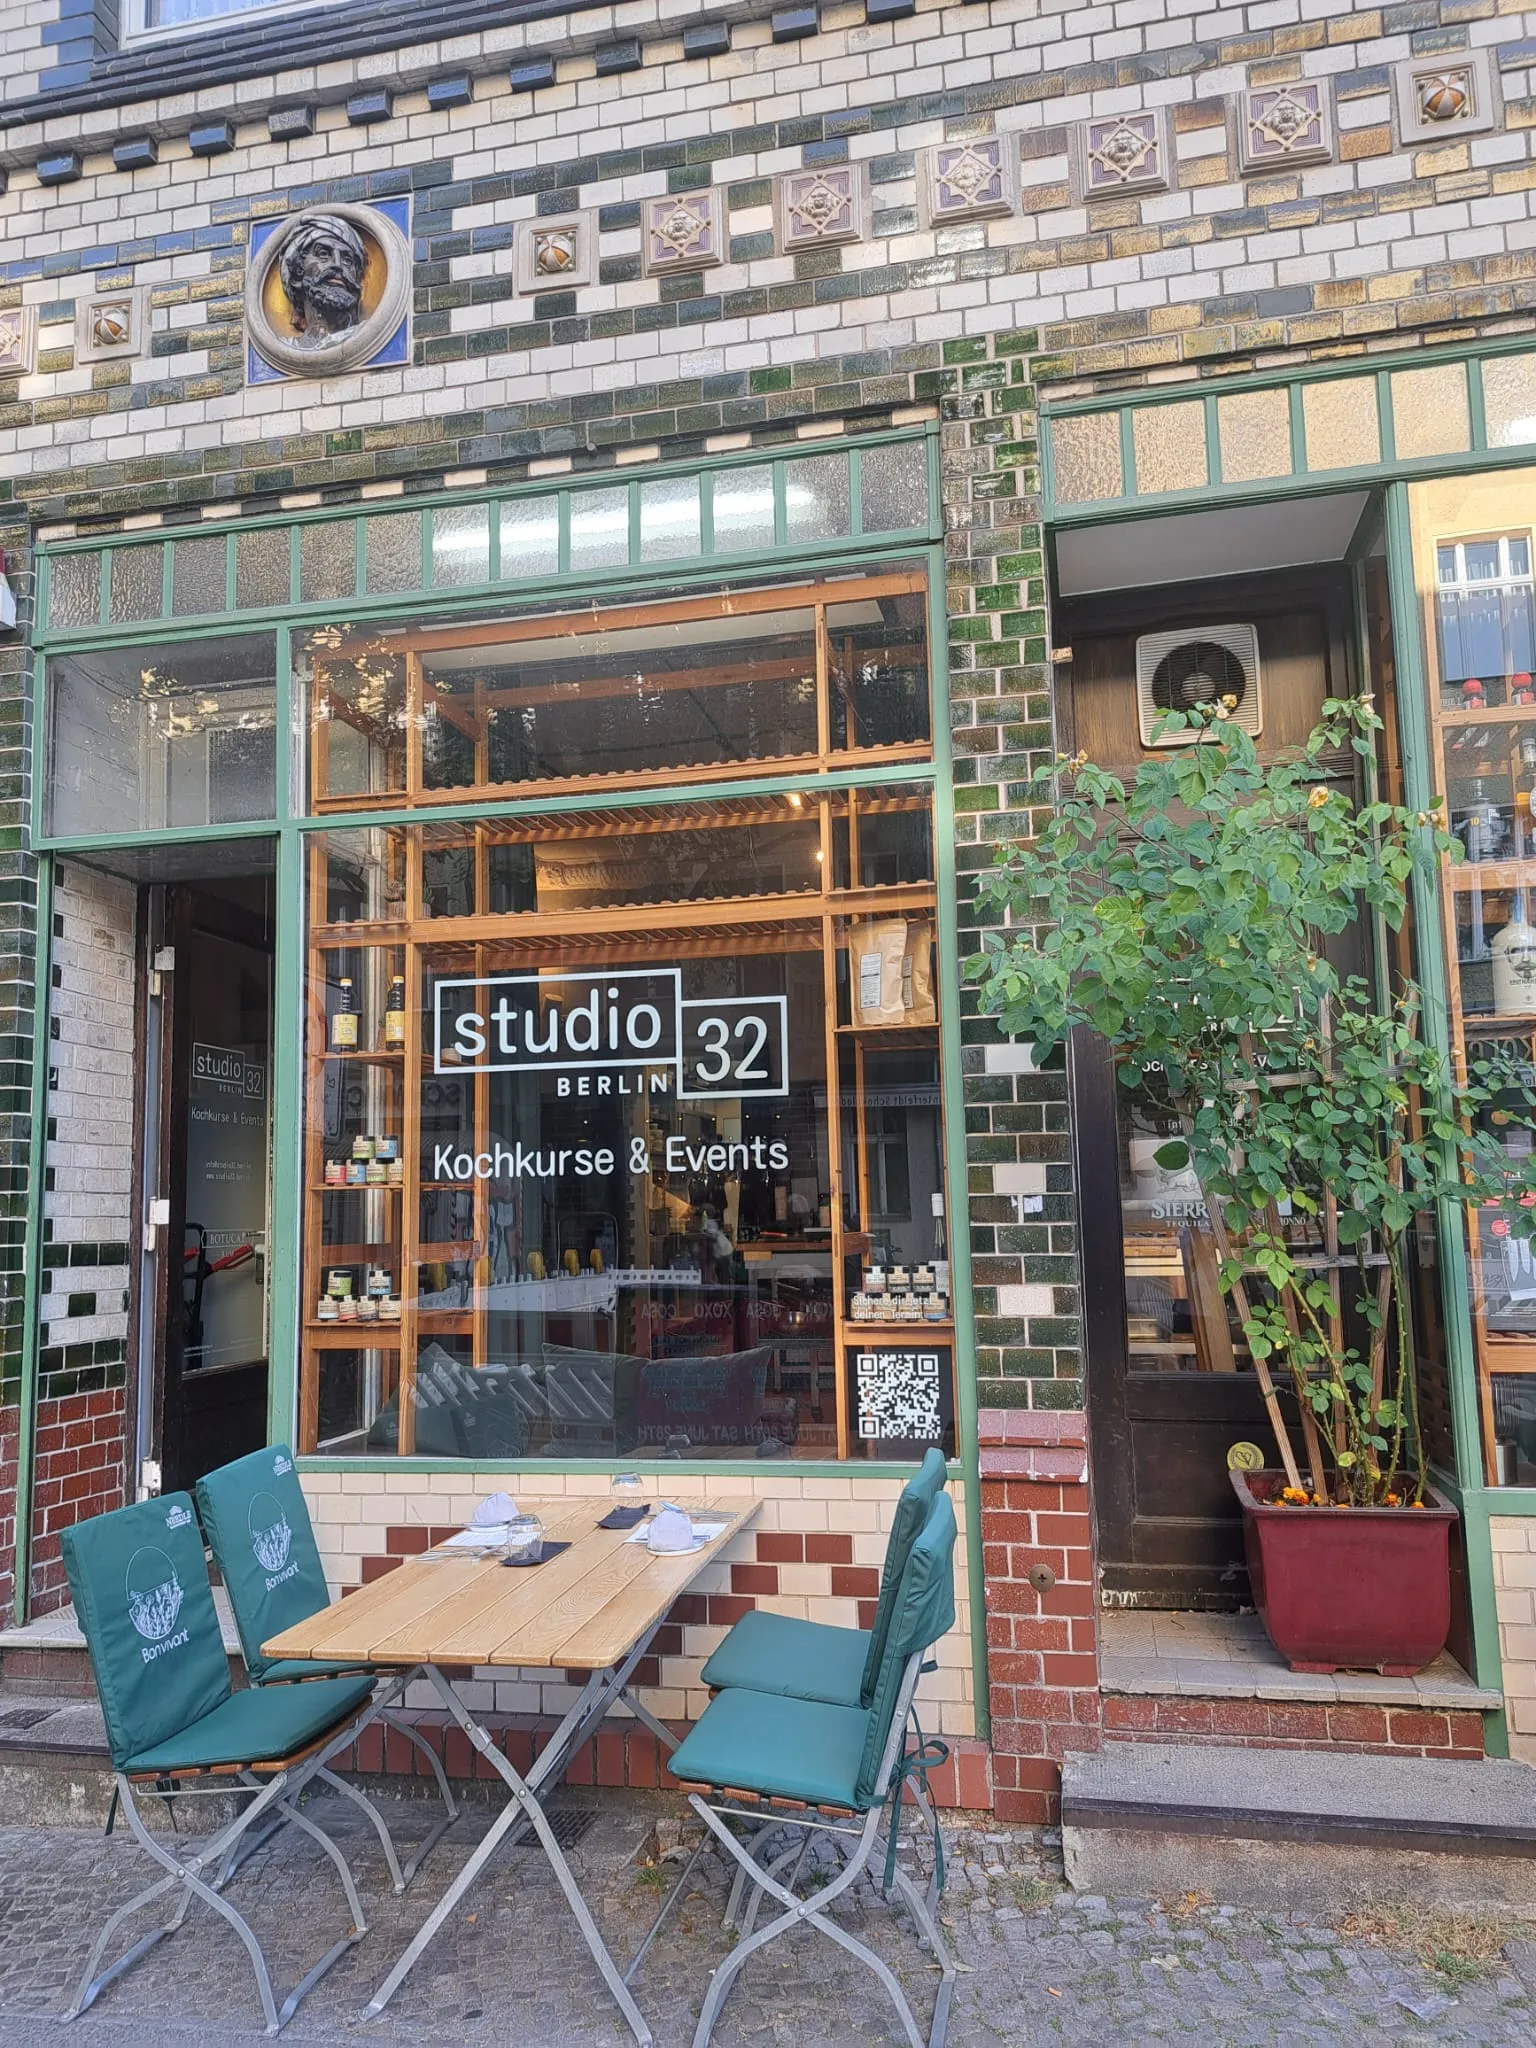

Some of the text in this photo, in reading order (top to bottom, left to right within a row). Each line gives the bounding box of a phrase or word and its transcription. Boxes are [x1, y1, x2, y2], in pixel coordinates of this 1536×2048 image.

[454, 987, 662, 1057] studio
[695, 1015, 769, 1082] 32
[196, 1052, 261, 1093] studio 32
[557, 1072, 669, 1097] BERLIN
[191, 1105, 230, 1123] Kochkurse
[240, 1112, 264, 1126] Events
[434, 1141, 615, 1181] Kochkurse
[628, 1136, 650, 1174] &
[666, 1135, 789, 1173] Events
[1151, 1199, 1223, 1219] SIERR
[1165, 1220, 1211, 1228] TEQUILA
[141, 1627, 190, 1665] Bonvivant
